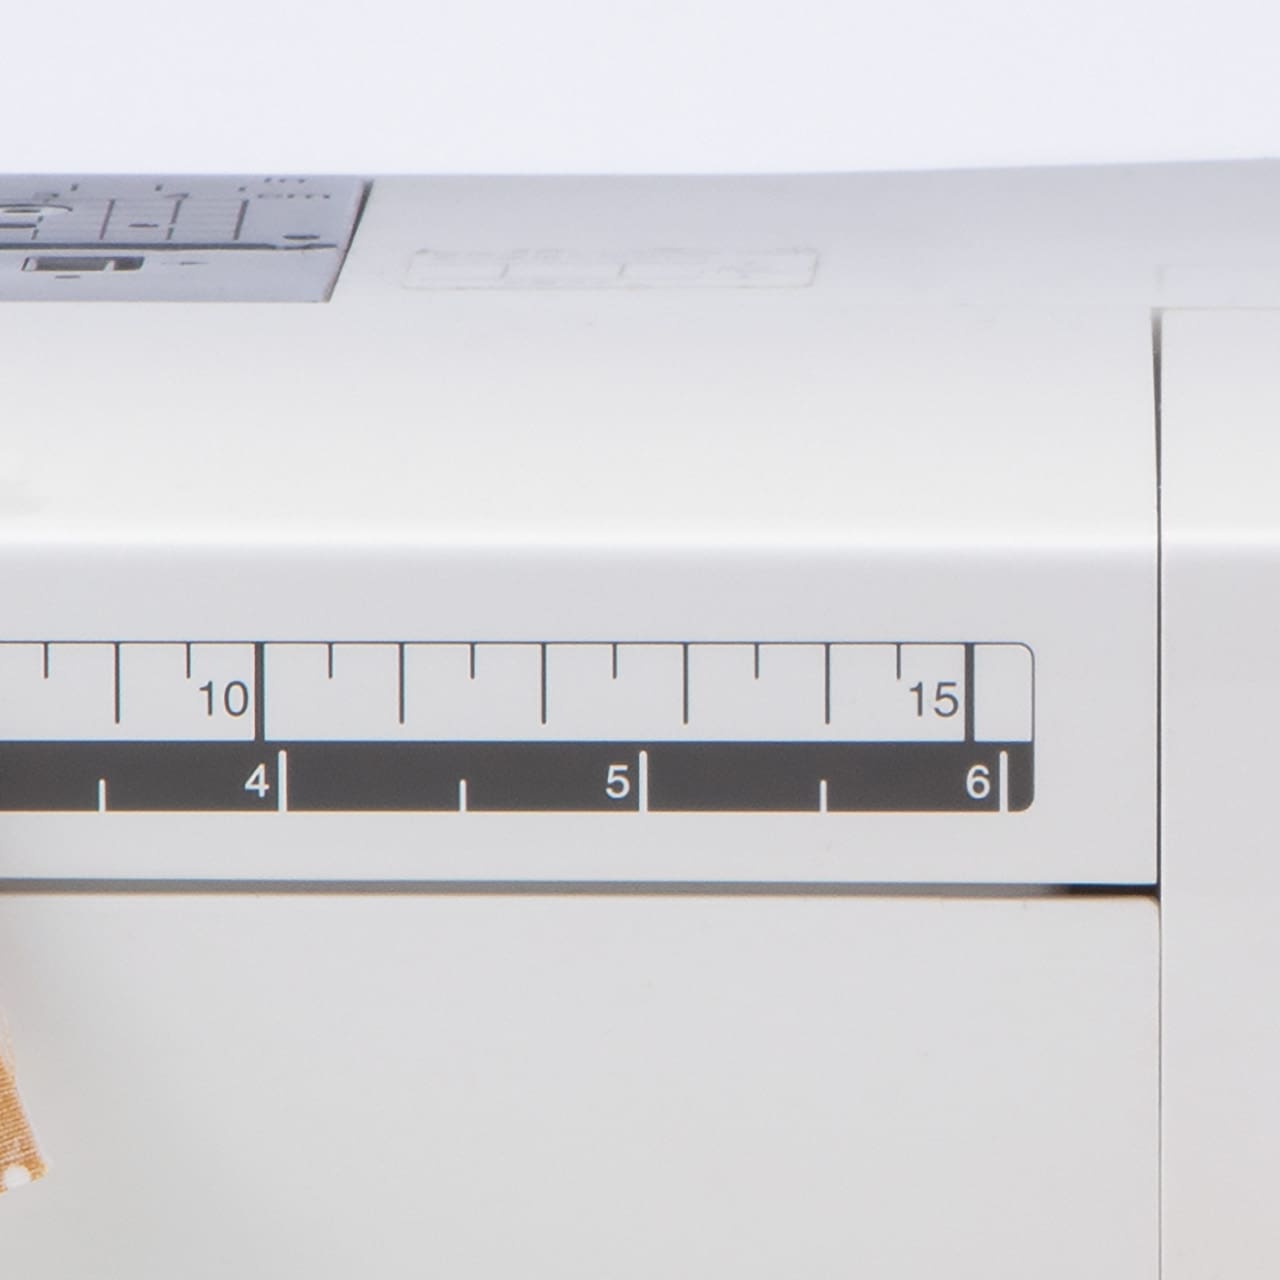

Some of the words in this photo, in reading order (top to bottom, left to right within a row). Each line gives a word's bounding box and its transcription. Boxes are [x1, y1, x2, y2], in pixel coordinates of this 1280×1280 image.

[199, 681, 249, 718] 10
[910, 681, 959, 718] 15
[244, 764, 270, 798] 4
[605, 764, 631, 799] 5
[965, 764, 991, 799] 6
